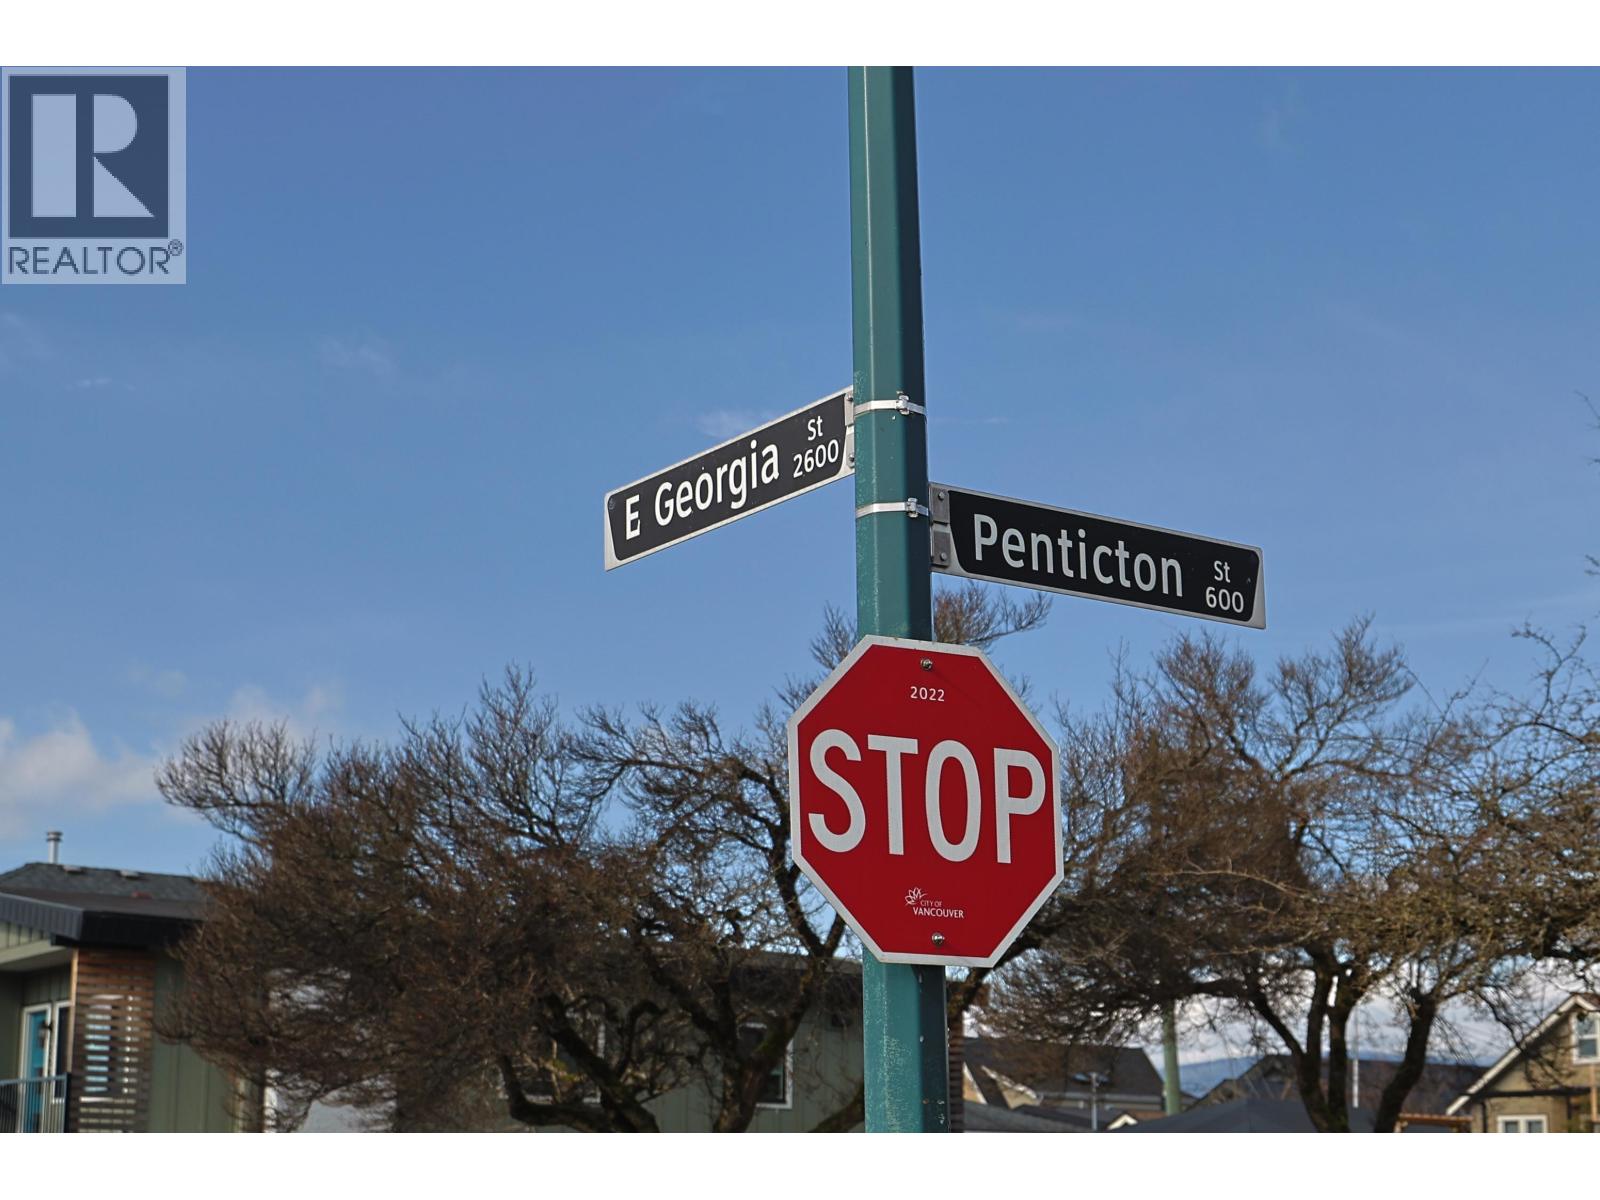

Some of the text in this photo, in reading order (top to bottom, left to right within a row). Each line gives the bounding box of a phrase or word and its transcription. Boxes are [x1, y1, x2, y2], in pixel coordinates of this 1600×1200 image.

[807, 415, 823, 441] St
[793, 439, 839, 479] 2600
[625, 439, 780, 540] E Georgia
[973, 513, 1183, 598] Penticton
[1213, 560, 1231, 583] St
[1205, 586, 1244, 613] 600
[910, 686, 945, 702] 2022
[808, 728, 1046, 864] STOP
[912, 906, 964, 919] VANCOUVER
[920, 899, 933, 907] CITY
